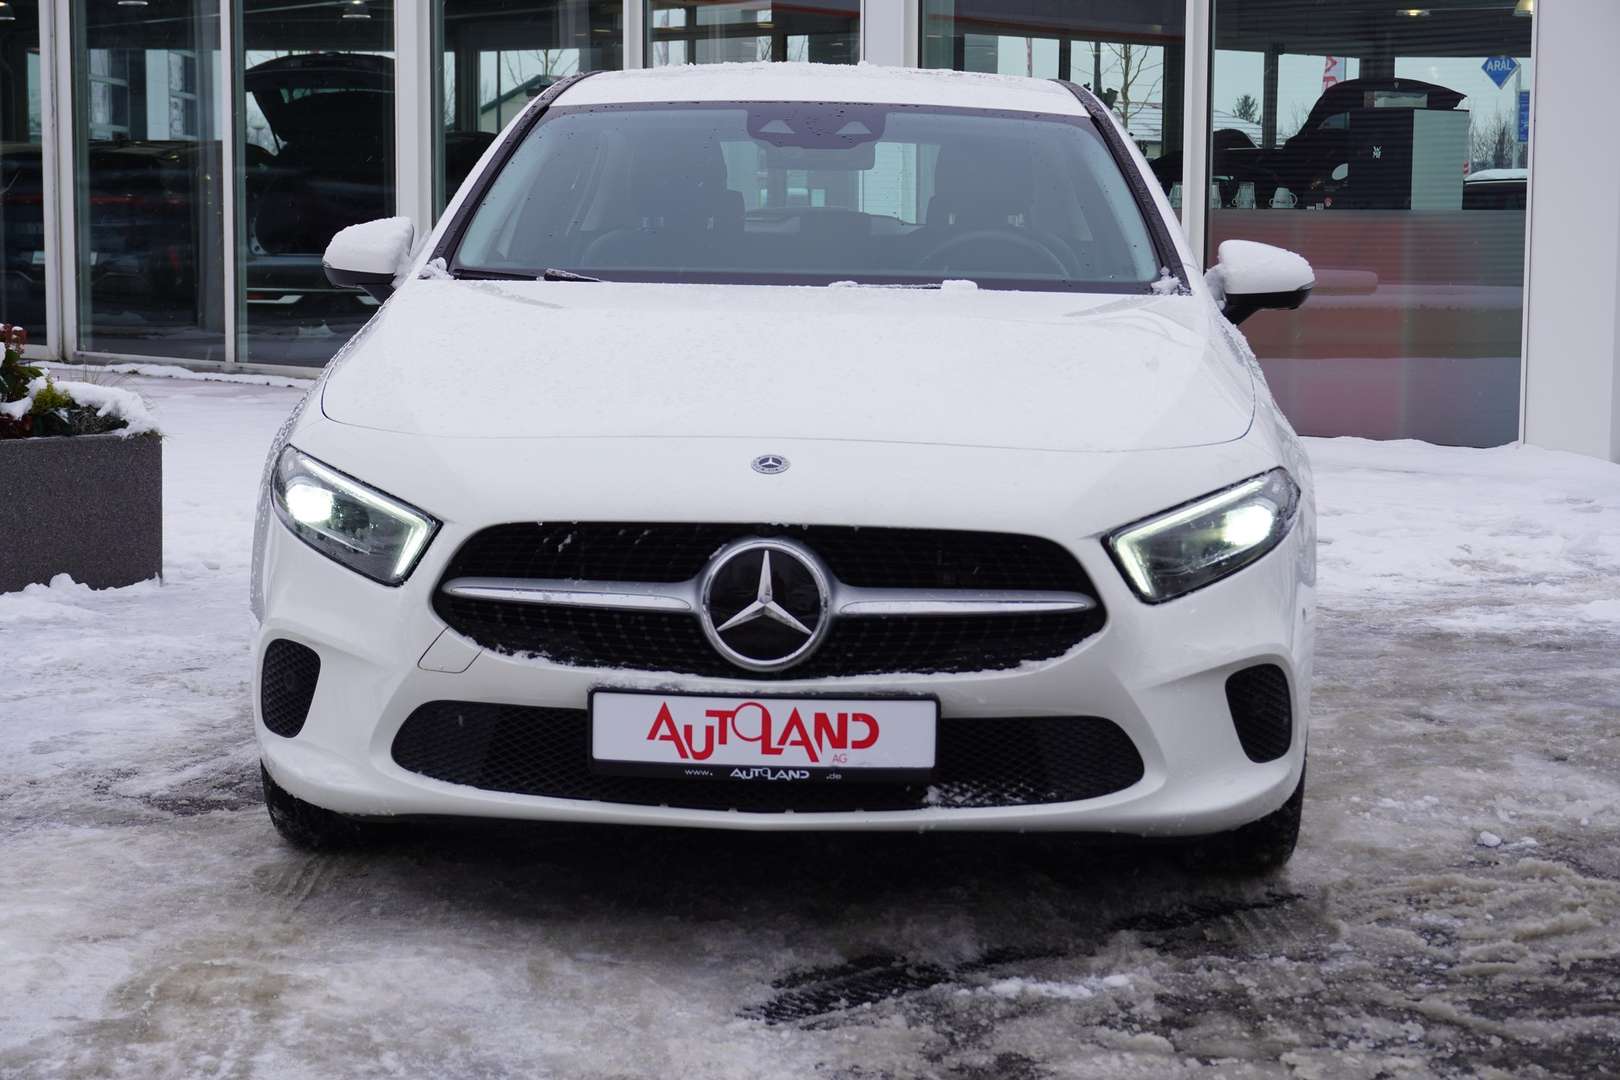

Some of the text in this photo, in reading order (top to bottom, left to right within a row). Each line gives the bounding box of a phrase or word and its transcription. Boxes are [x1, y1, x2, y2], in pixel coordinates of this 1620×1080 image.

[1486, 60, 1512, 72] ARAL
[646, 701, 880, 764] AUTOLAND
[832, 753, 848, 764] AG
[730, 767, 811, 781] AUTOLAND
